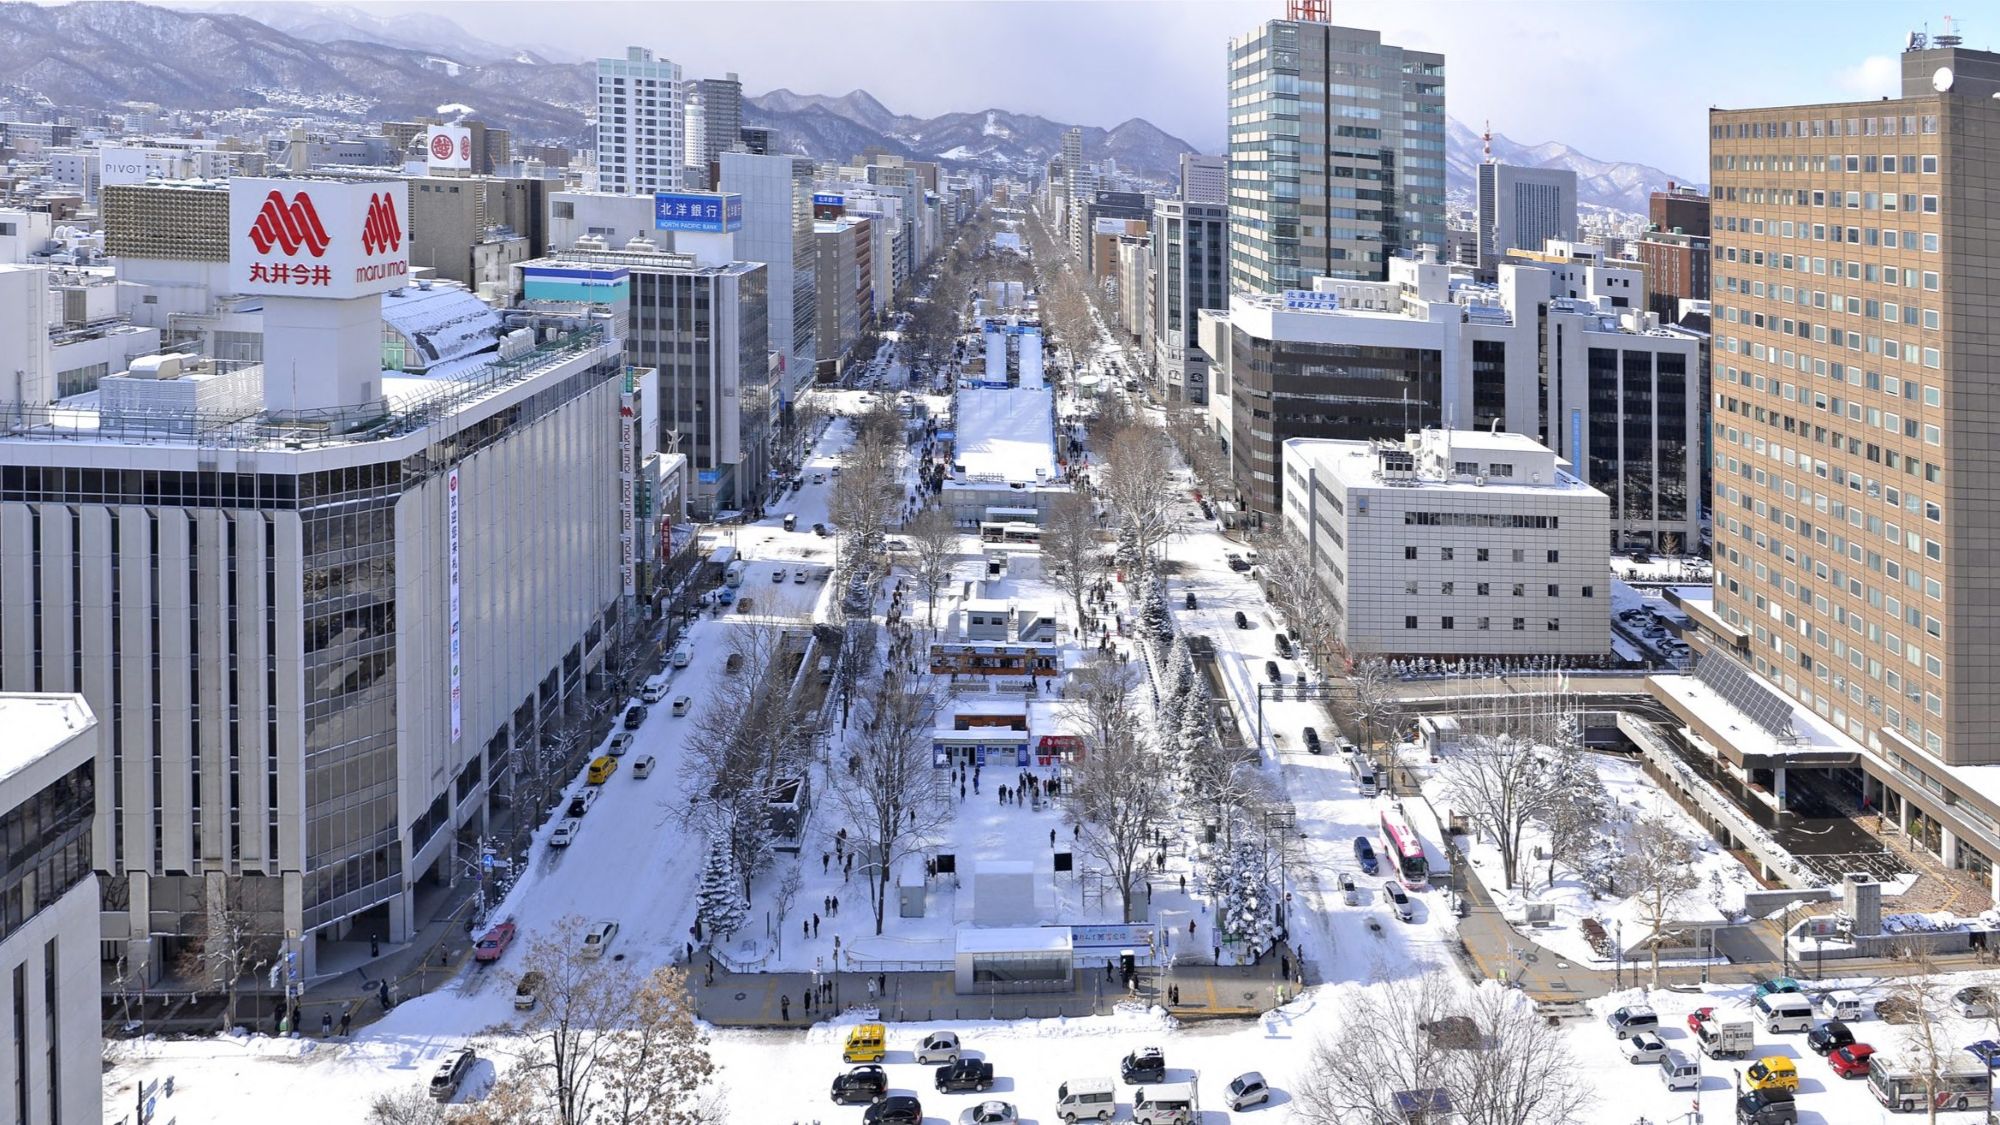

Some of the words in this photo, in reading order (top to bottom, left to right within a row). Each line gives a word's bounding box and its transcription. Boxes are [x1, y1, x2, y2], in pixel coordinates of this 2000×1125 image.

[105, 163, 142, 174] PIVOT
[660, 202, 717, 218] 北洋銀行
[249, 262, 332, 286] 丸井今井
[357, 263, 385, 283] marui
[624, 510, 632, 531] imai
[624, 536, 632, 564] marui
